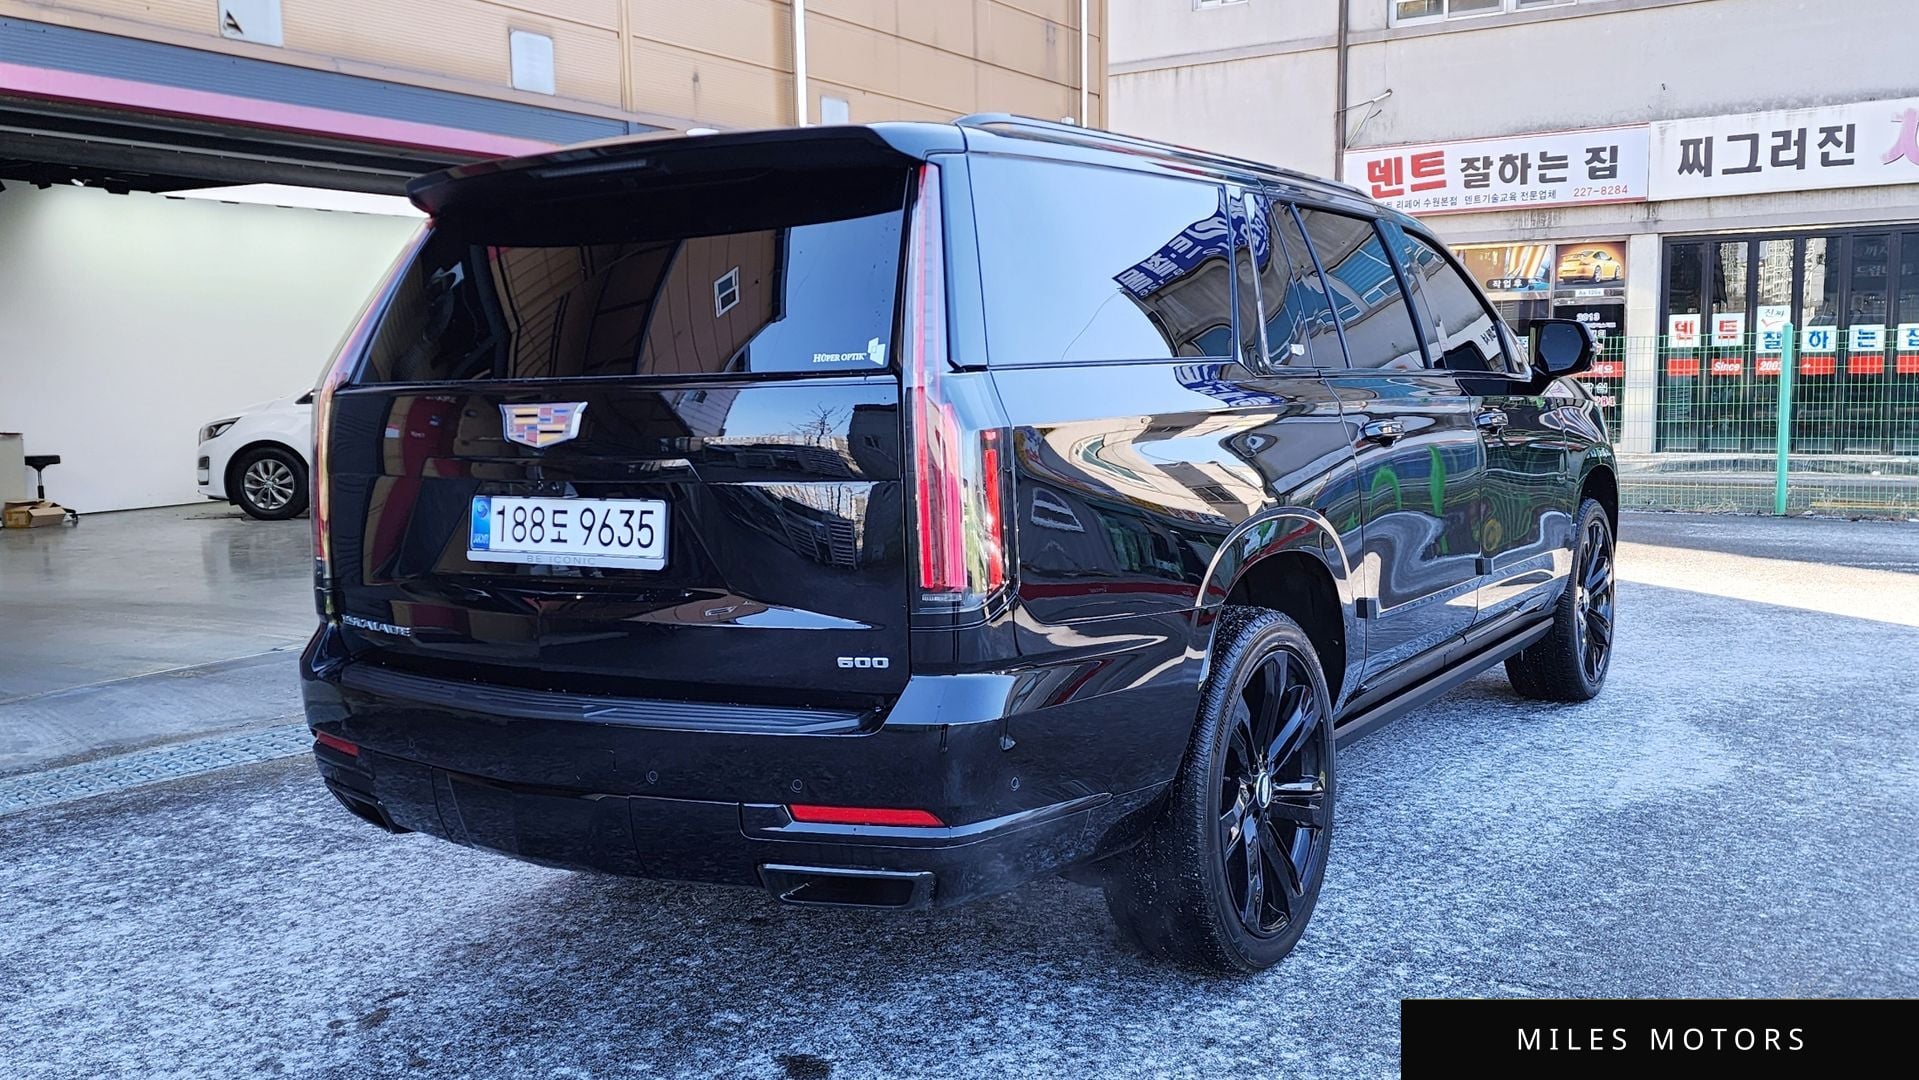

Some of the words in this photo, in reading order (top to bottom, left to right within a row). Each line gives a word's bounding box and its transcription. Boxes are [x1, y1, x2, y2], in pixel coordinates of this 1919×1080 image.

[1678, 123, 1856, 178] 찌그러진
[1367, 150, 1447, 199] 덴트
[1460, 151, 1569, 189] 잘하는
[1585, 145, 1619, 180] 집
[1396, 199, 1421, 210] 리페어
[1423, 196, 1458, 208] 수원본점
[1464, 191, 1517, 205] 덴트기술교육
[1520, 189, 1556, 201] 전문업체
[1573, 184, 1628, 198] 227-8284
[1713, 362, 1740, 371] Since
[497, 505, 568, 543] 188도
[579, 507, 655, 549] 9635
[526, 554, 543, 563] BE
[549, 556, 596, 565] ICONIC
[837, 656, 889, 669] 600
